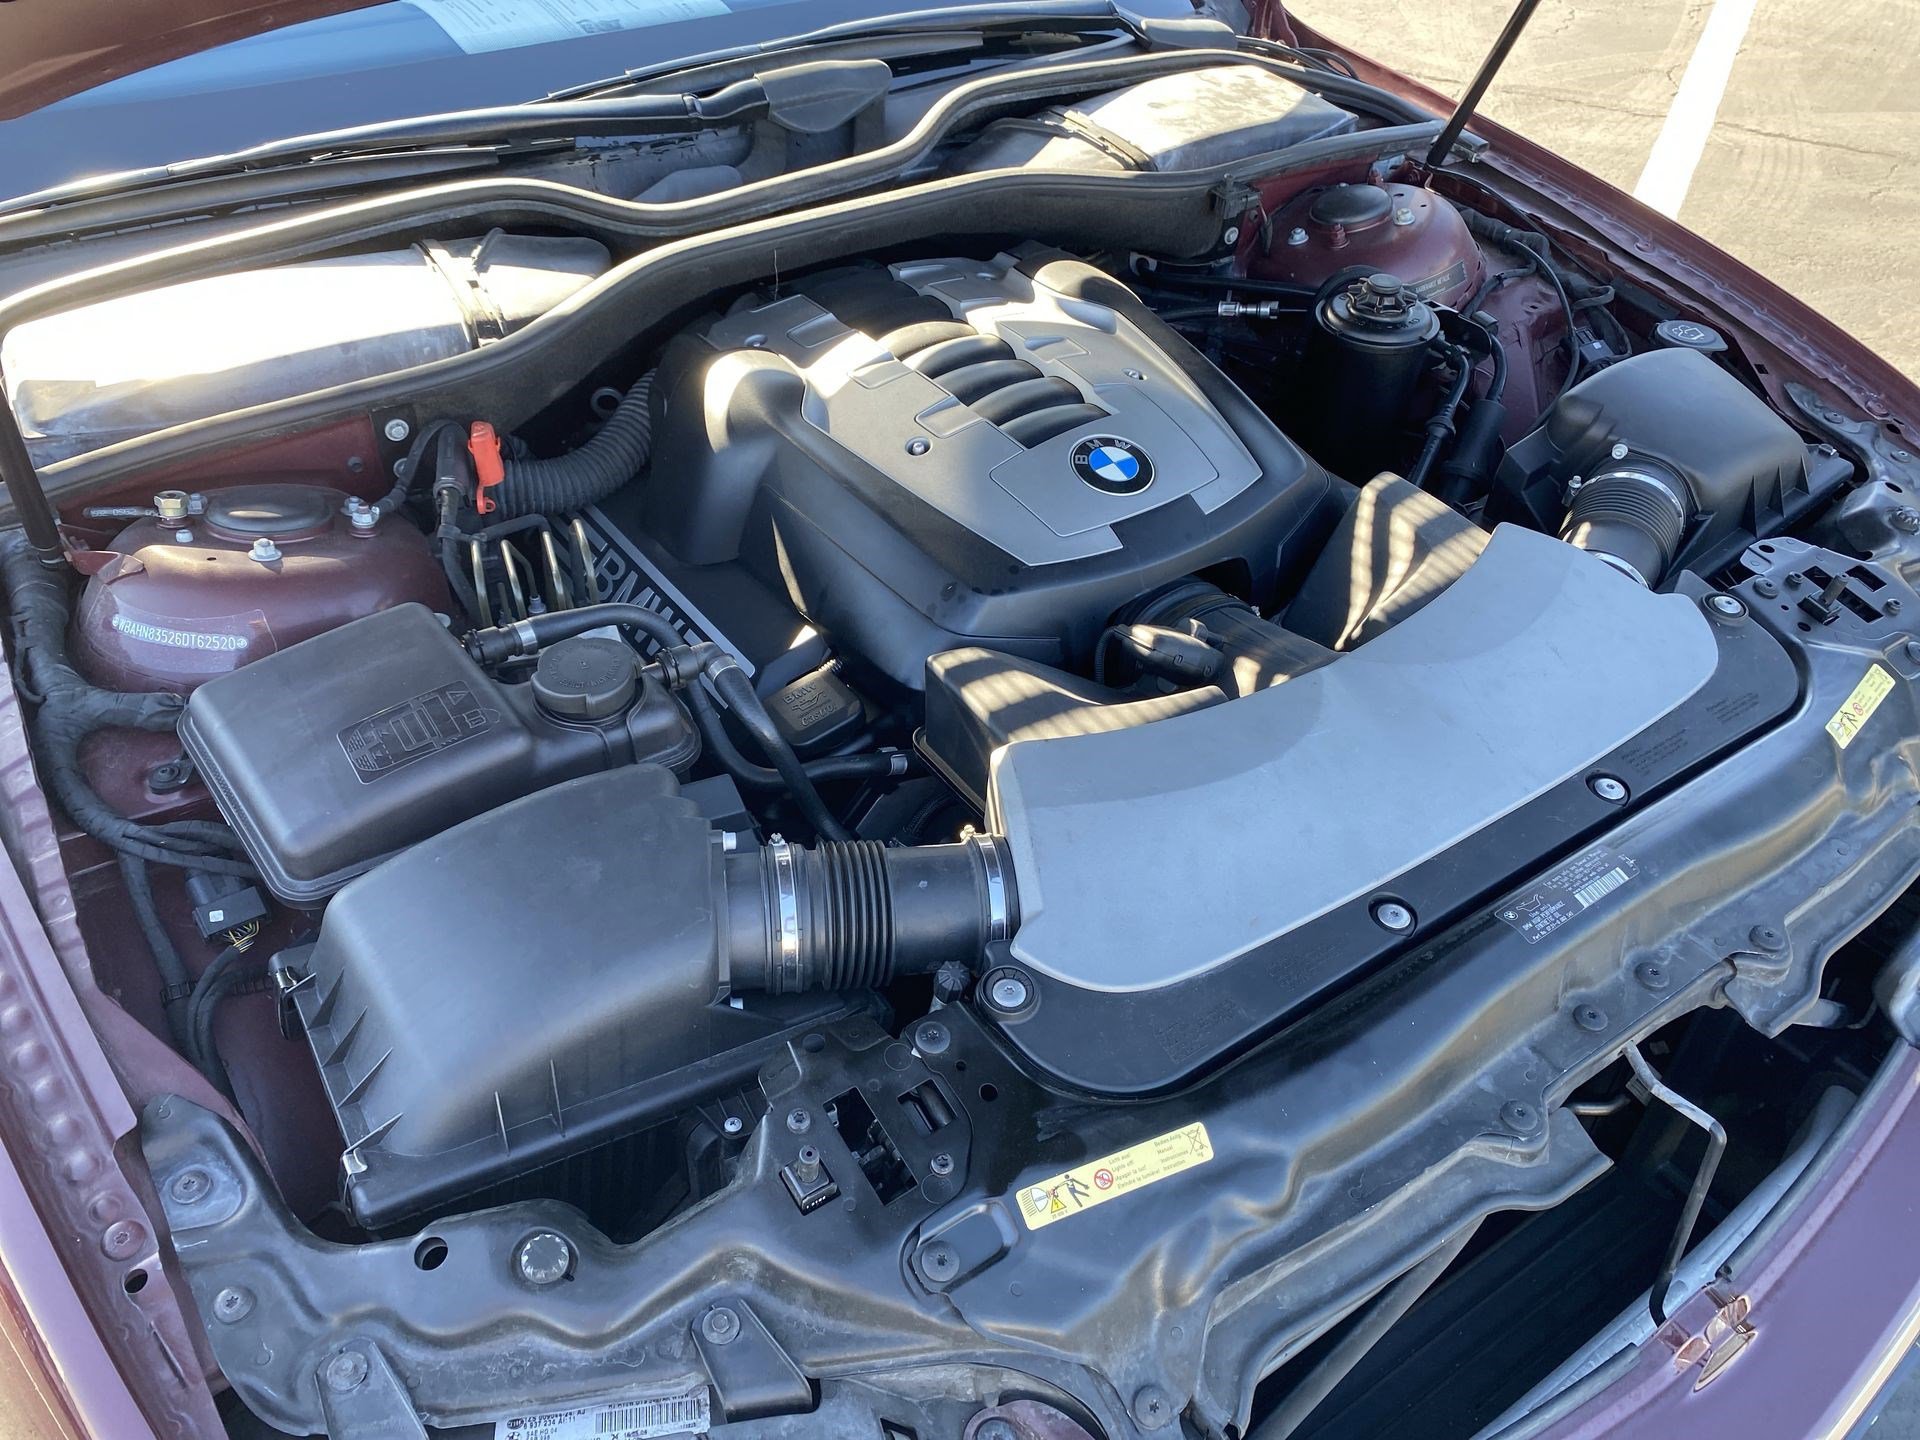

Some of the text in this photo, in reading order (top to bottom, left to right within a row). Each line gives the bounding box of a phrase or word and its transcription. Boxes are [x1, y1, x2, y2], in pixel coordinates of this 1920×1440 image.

[1075, 440, 1131, 464] BMW
[118, 618, 236, 650] WBAHN83526DT62520
[783, 681, 817, 704] BMW
